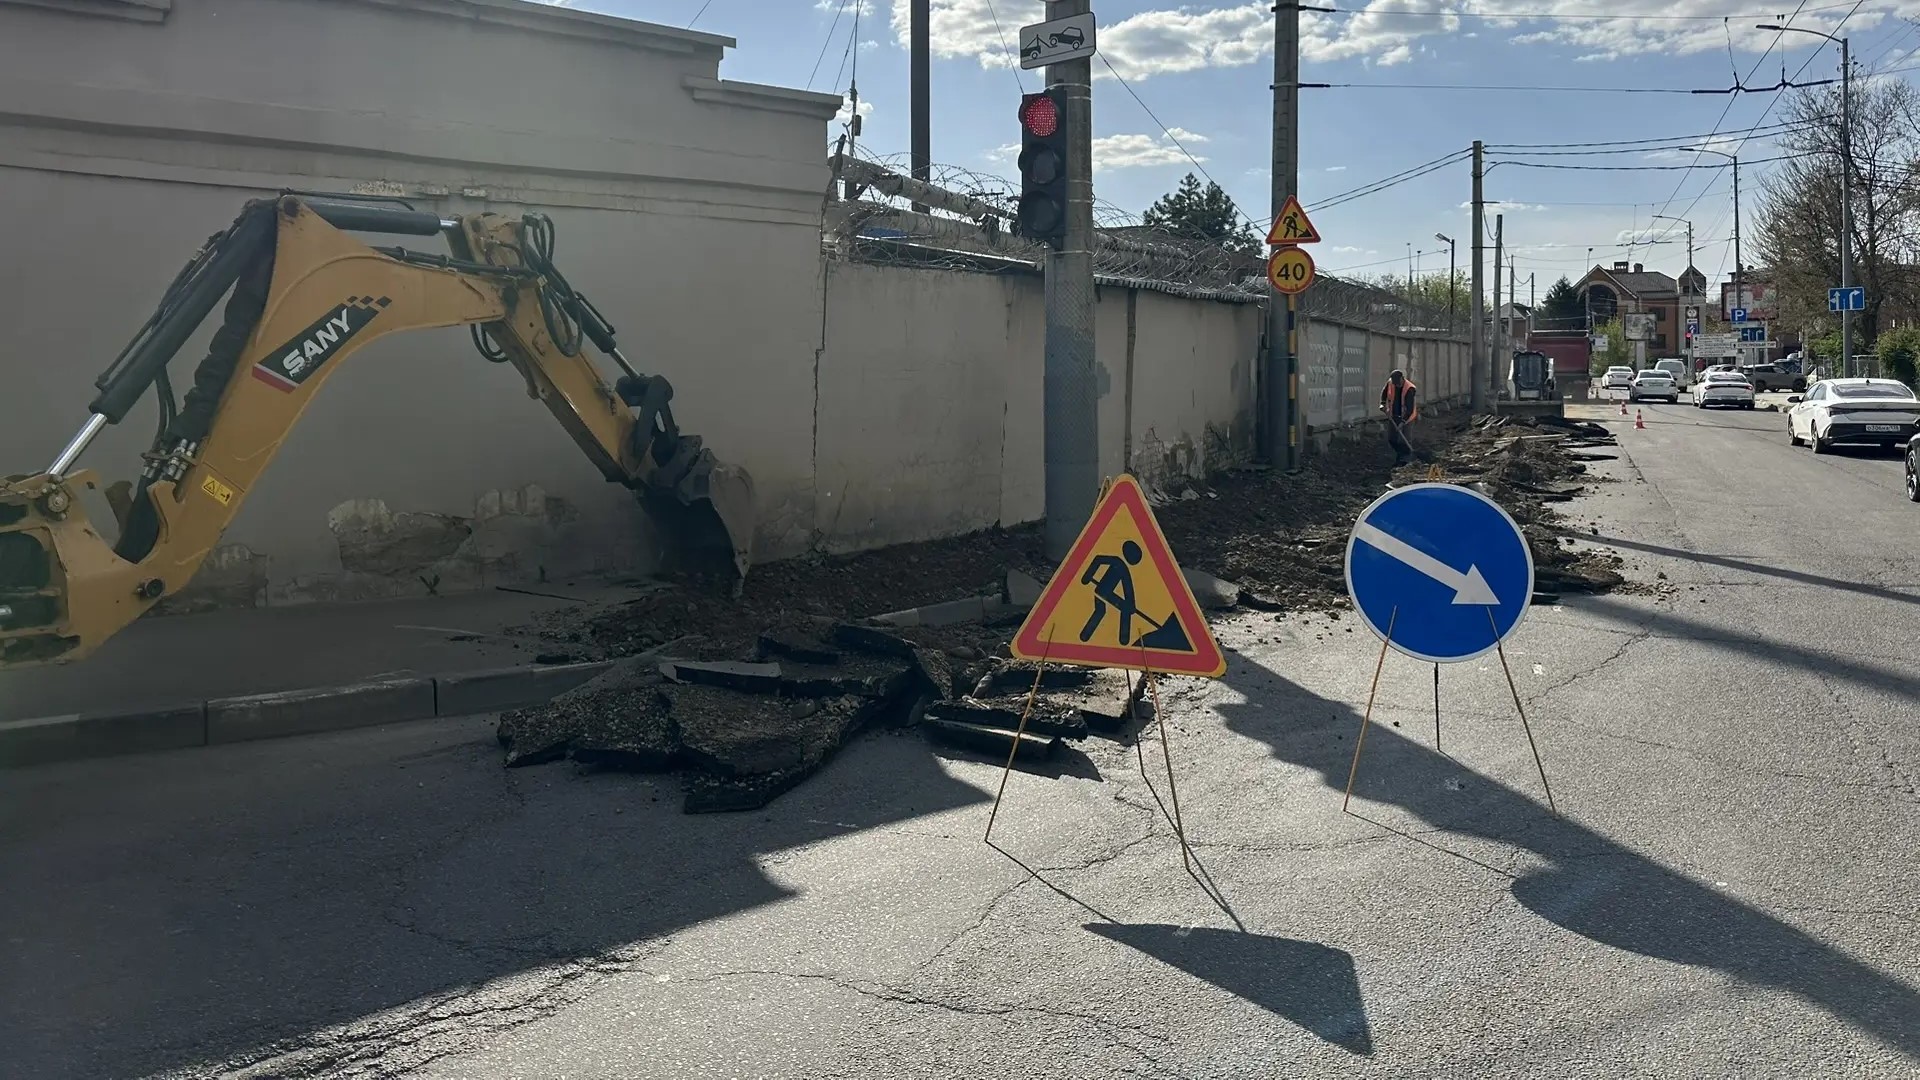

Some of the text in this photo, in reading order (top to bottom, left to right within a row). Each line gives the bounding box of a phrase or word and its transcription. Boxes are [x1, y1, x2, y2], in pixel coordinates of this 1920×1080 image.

[1277, 262, 1306, 281] 40
[1735, 309, 1744, 321] P
[283, 308, 351, 377] SANY
